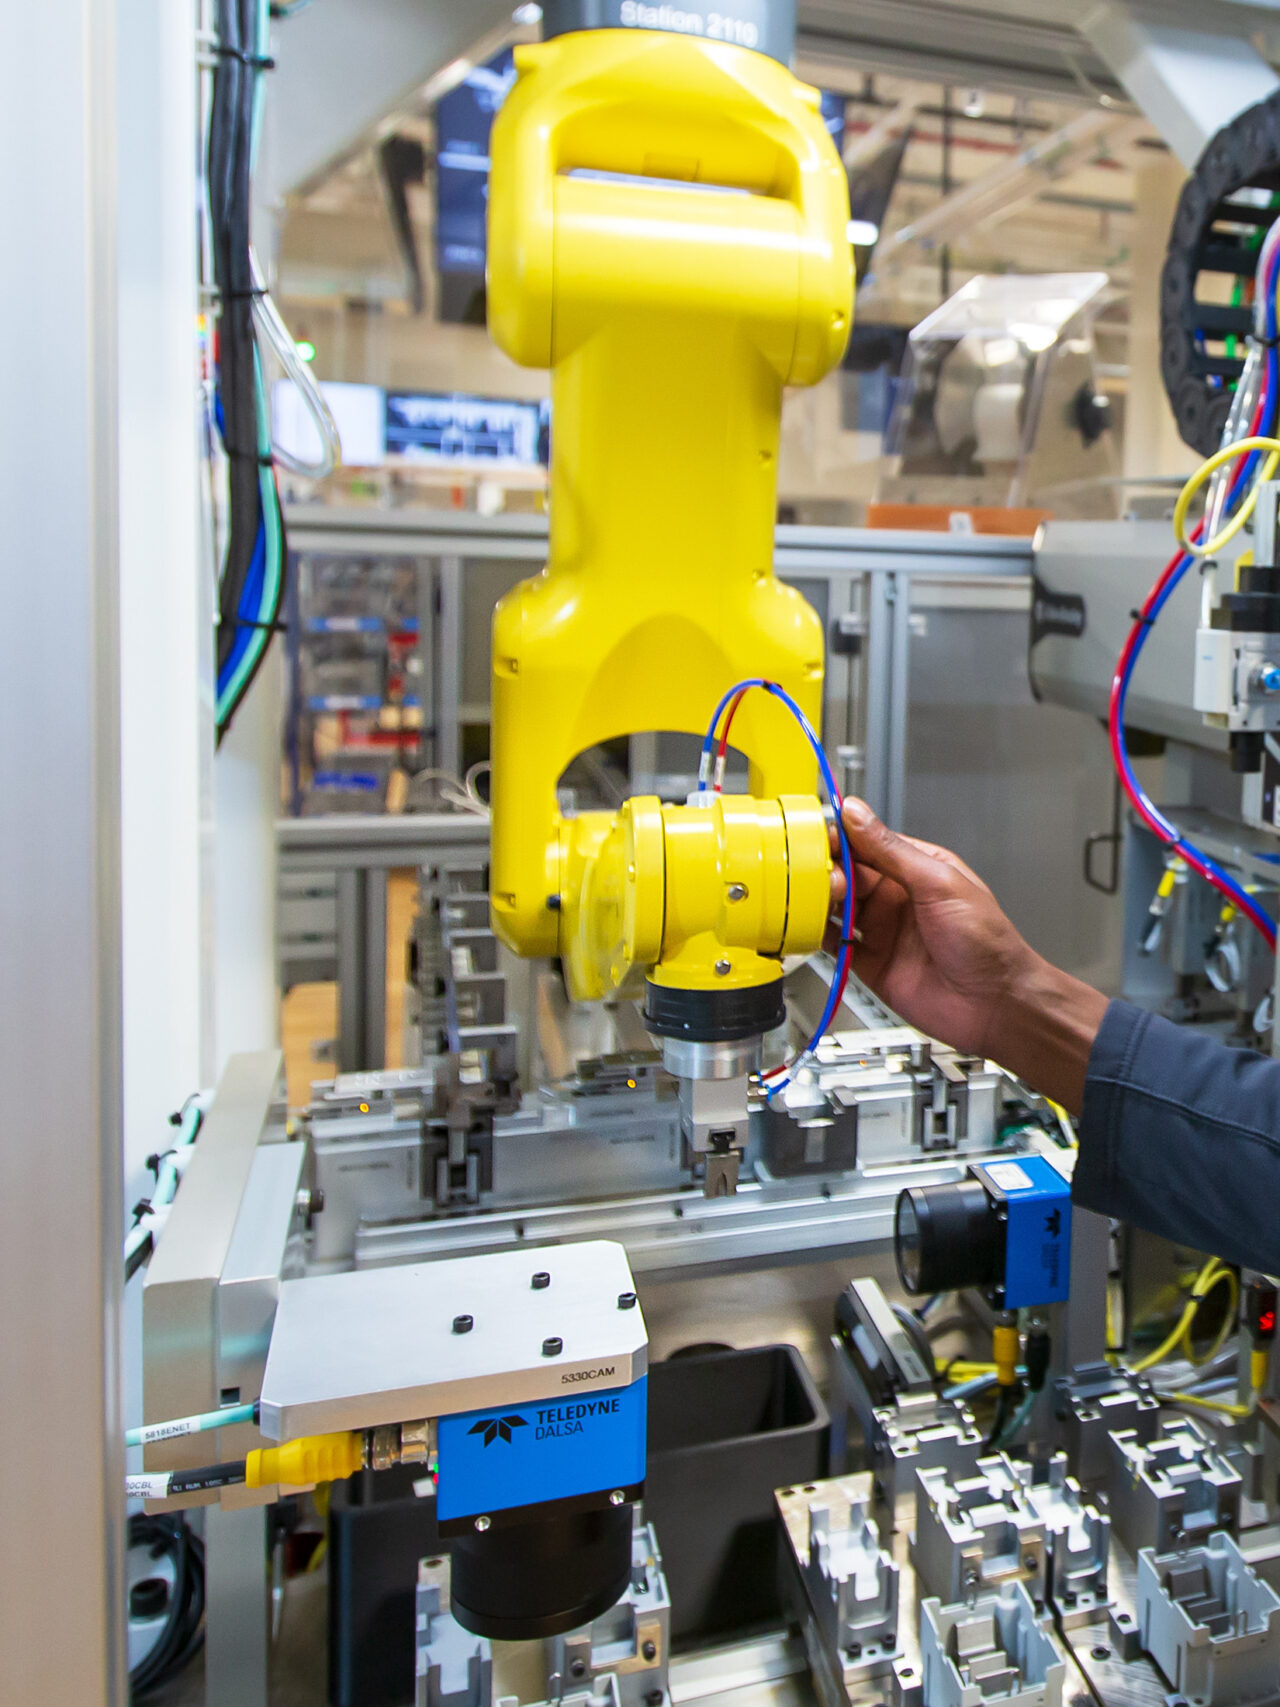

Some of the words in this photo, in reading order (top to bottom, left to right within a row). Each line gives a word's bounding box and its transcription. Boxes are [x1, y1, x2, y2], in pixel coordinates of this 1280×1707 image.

[620, 0, 704, 34] Station
[706, 12, 758, 48] 2110
[561, 1366, 616, 1384] 5330CAM
[536, 1398, 620, 1425] TELEDYNE
[535, 1420, 584, 1441] DALSA
